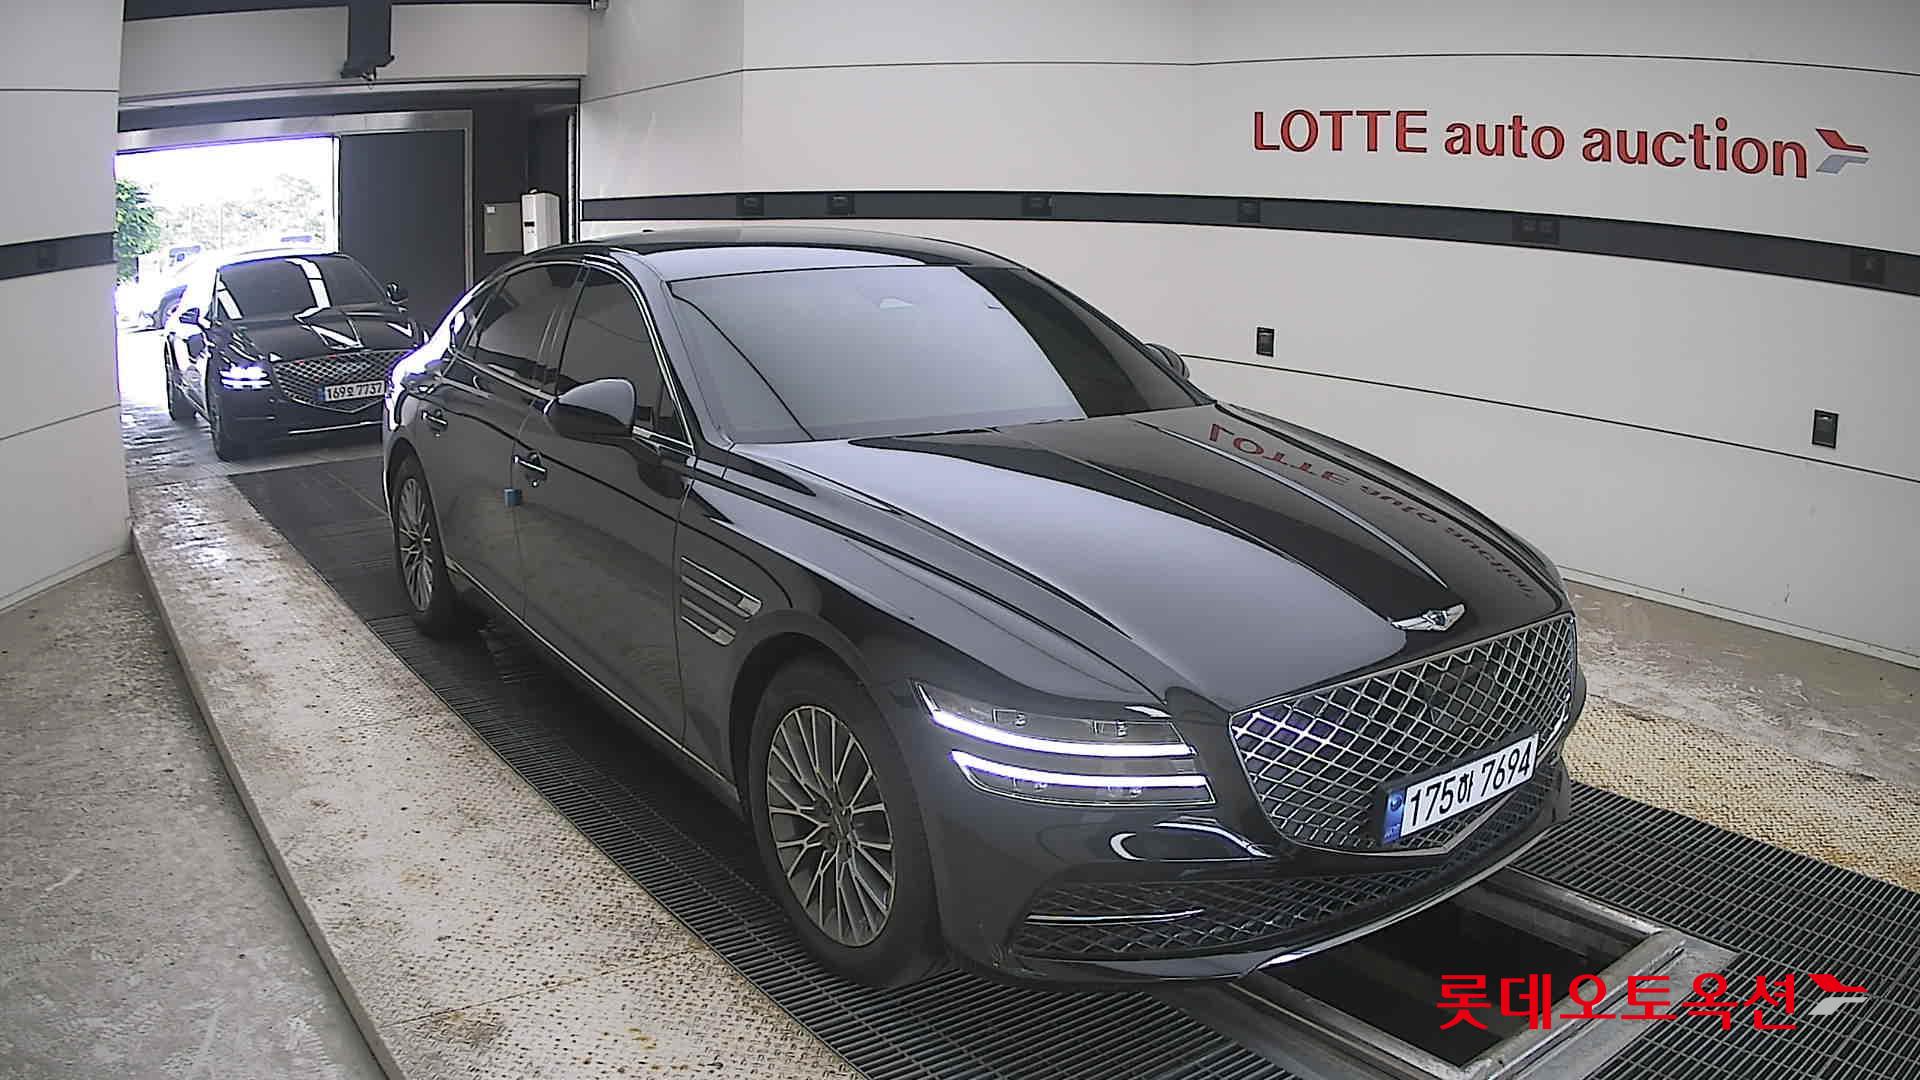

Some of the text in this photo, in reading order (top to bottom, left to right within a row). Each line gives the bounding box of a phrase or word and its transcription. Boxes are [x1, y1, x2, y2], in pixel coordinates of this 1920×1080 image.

[1253, 109, 1808, 179] LOTTE auto auction
[1410, 742, 1532, 827] 175하 7694
